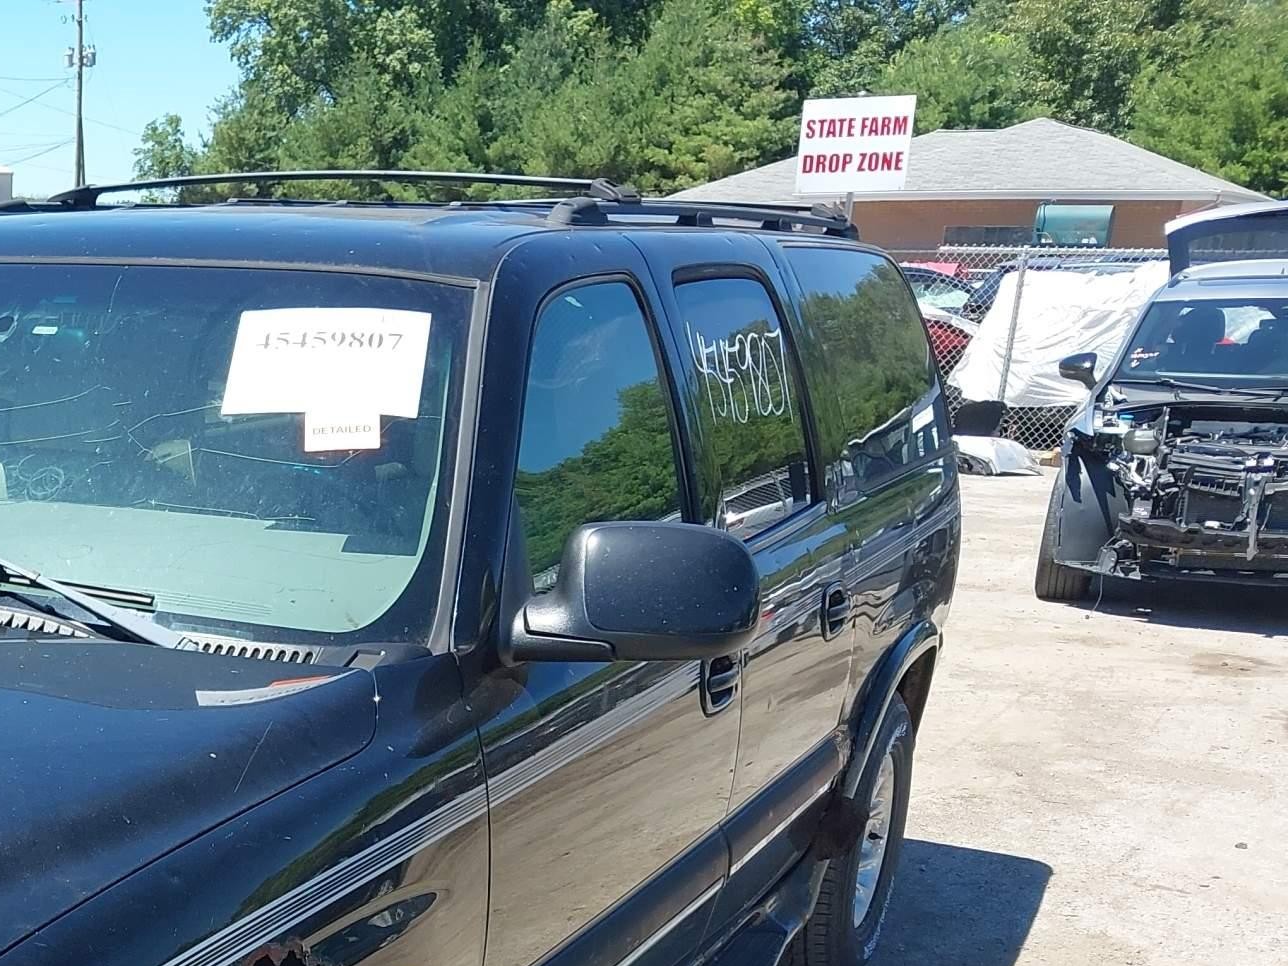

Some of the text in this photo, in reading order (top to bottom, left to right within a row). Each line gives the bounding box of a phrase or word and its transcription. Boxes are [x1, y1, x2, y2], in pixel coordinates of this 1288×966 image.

[805, 115, 909, 139] STATE FARM
[802, 151, 905, 174] DROP ZONE
[255, 331, 404, 351] 45459807
[686, 321, 793, 425] 45459807
[312, 424, 372, 436] DETAILED
